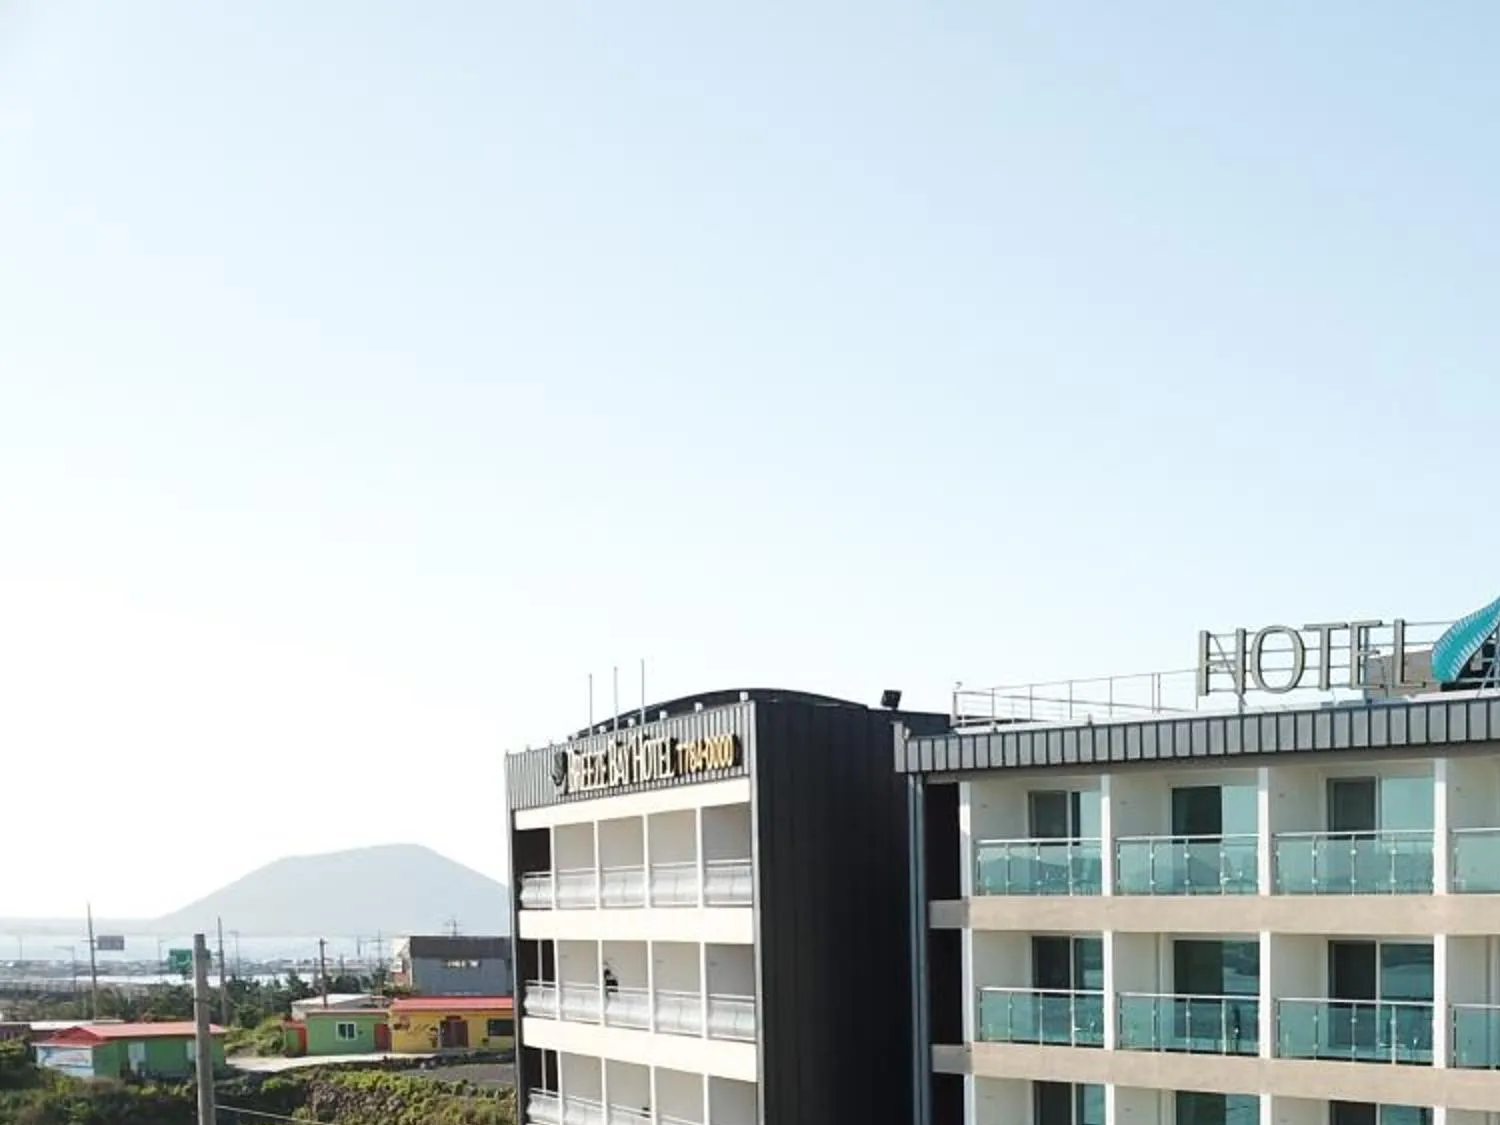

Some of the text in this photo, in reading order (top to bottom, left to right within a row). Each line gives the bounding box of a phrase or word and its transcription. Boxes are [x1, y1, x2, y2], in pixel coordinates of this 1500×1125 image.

[1198, 618, 1428, 696] HOTEL
[608, 735, 632, 787] BAY
[632, 731, 675, 782] HOTEL
